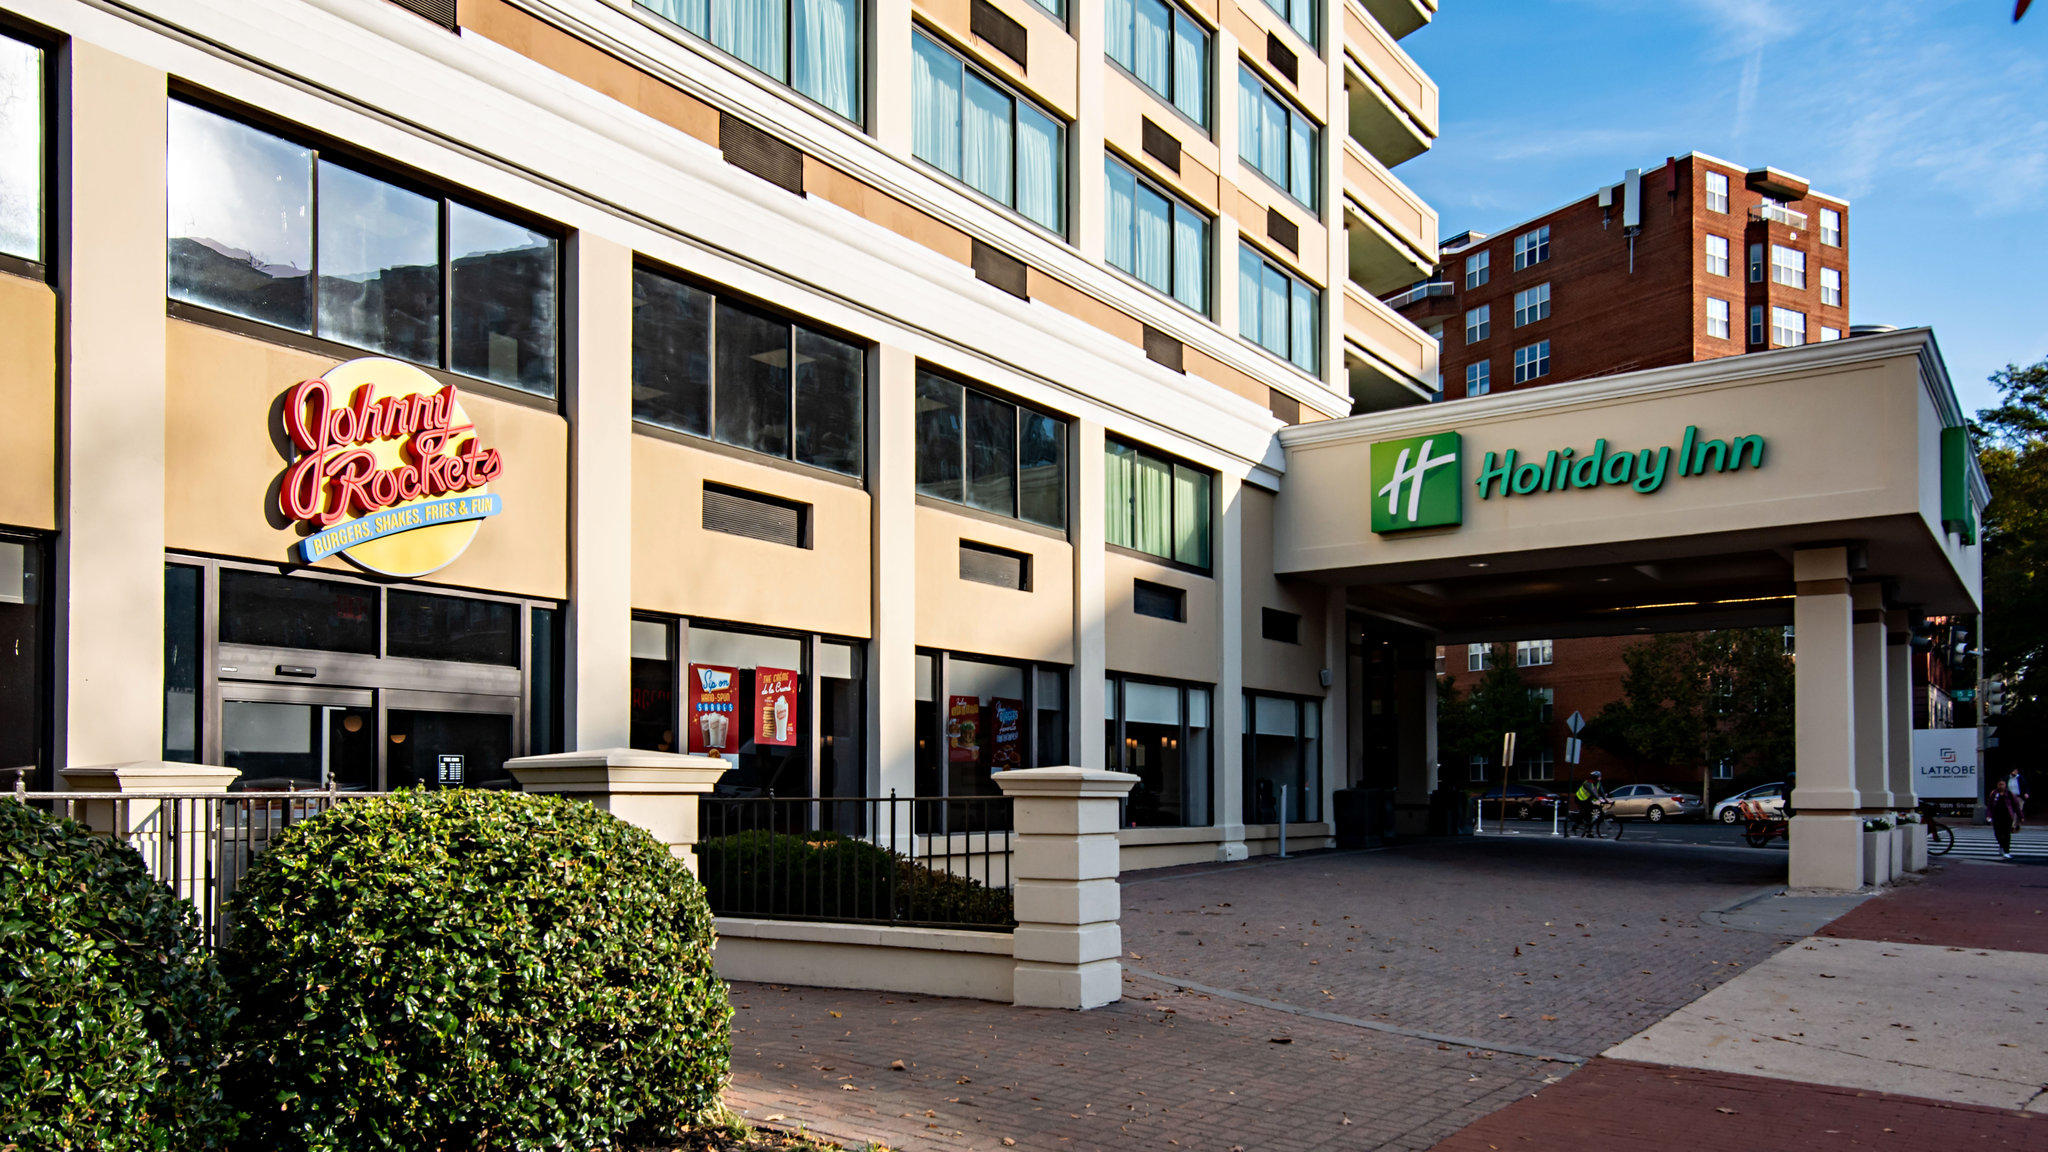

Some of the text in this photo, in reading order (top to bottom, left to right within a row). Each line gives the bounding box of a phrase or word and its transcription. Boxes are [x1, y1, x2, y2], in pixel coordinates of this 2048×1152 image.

[282, 378, 475, 520] Johnny
[1475, 424, 1766, 500] Holiday Inn
[312, 437, 504, 526] Rockets
[313, 497, 493, 556] BURGERS, SHAKES, FRIES & FUN
[700, 693, 731, 703] HAND-SPUN
[702, 669, 730, 694] Sip on
[1921, 765, 1976, 775] LATROBE
